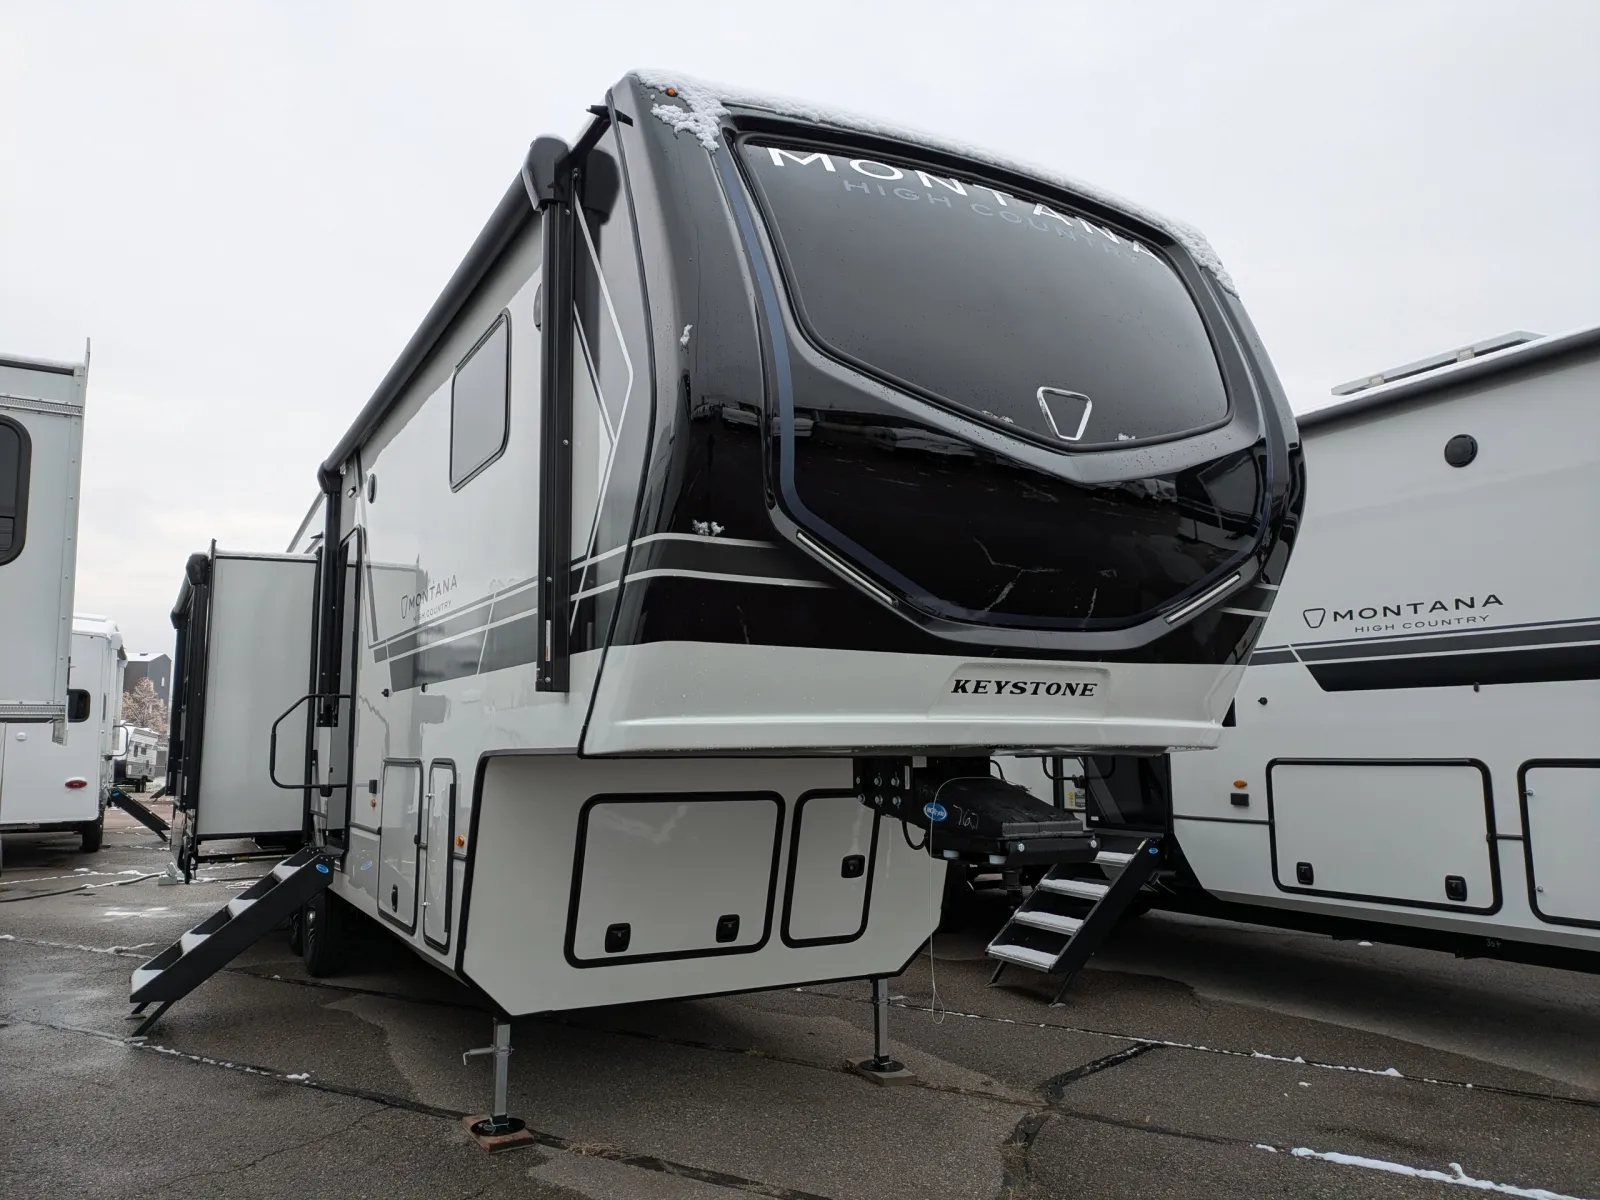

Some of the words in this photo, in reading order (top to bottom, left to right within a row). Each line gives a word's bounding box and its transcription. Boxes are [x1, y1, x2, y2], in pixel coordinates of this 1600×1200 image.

[767, 147, 1165, 266] MONTANA
[843, 180, 952, 208] HIGH
[409, 575, 457, 610] MONTANA
[426, 600, 452, 617] COUNTRY
[1333, 594, 1503, 622] MONTANA
[1355, 623, 1395, 633] HIGH
[1402, 614, 1490, 629] COUNTRY
[951, 679, 1098, 697] KEYSTONE
